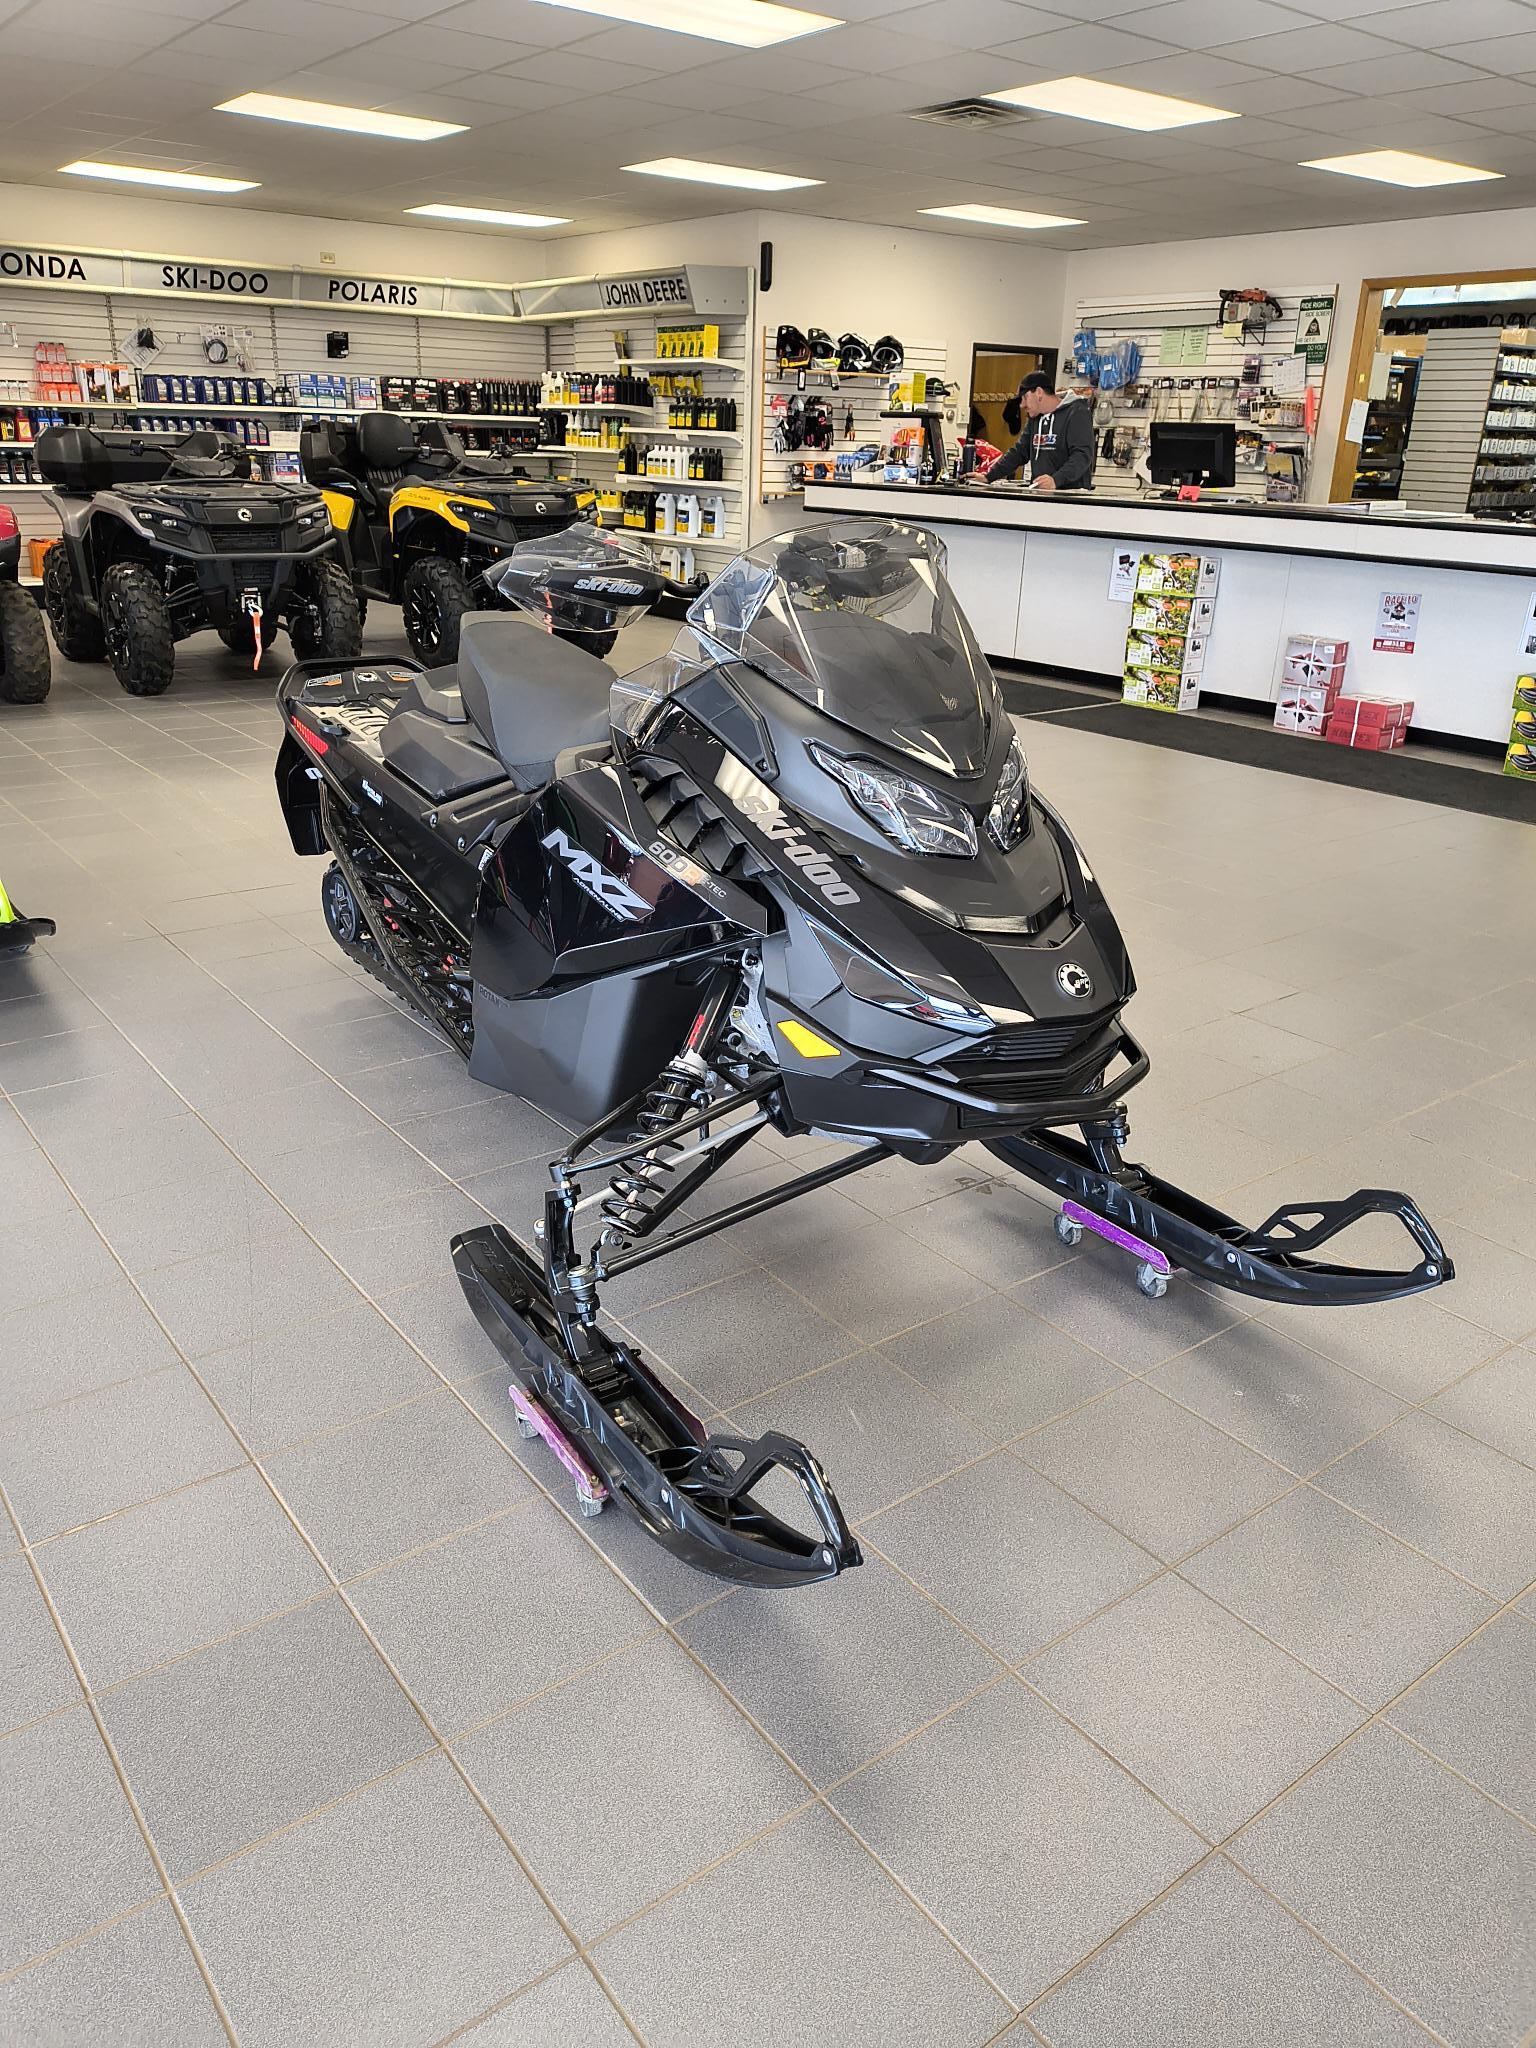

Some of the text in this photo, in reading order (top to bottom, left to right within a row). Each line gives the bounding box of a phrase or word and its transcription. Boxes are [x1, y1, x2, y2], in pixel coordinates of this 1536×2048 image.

[161, 265, 269, 294] SKI-DOO
[328, 279, 418, 306] POLARIS
[605, 278, 687, 306] JOHN DEERE
[573, 576, 645, 596] ski-doo
[732, 795, 861, 906] ski-doo
[541, 828, 655, 920] MXZ
[573, 877, 624, 922] ADRENALINE
